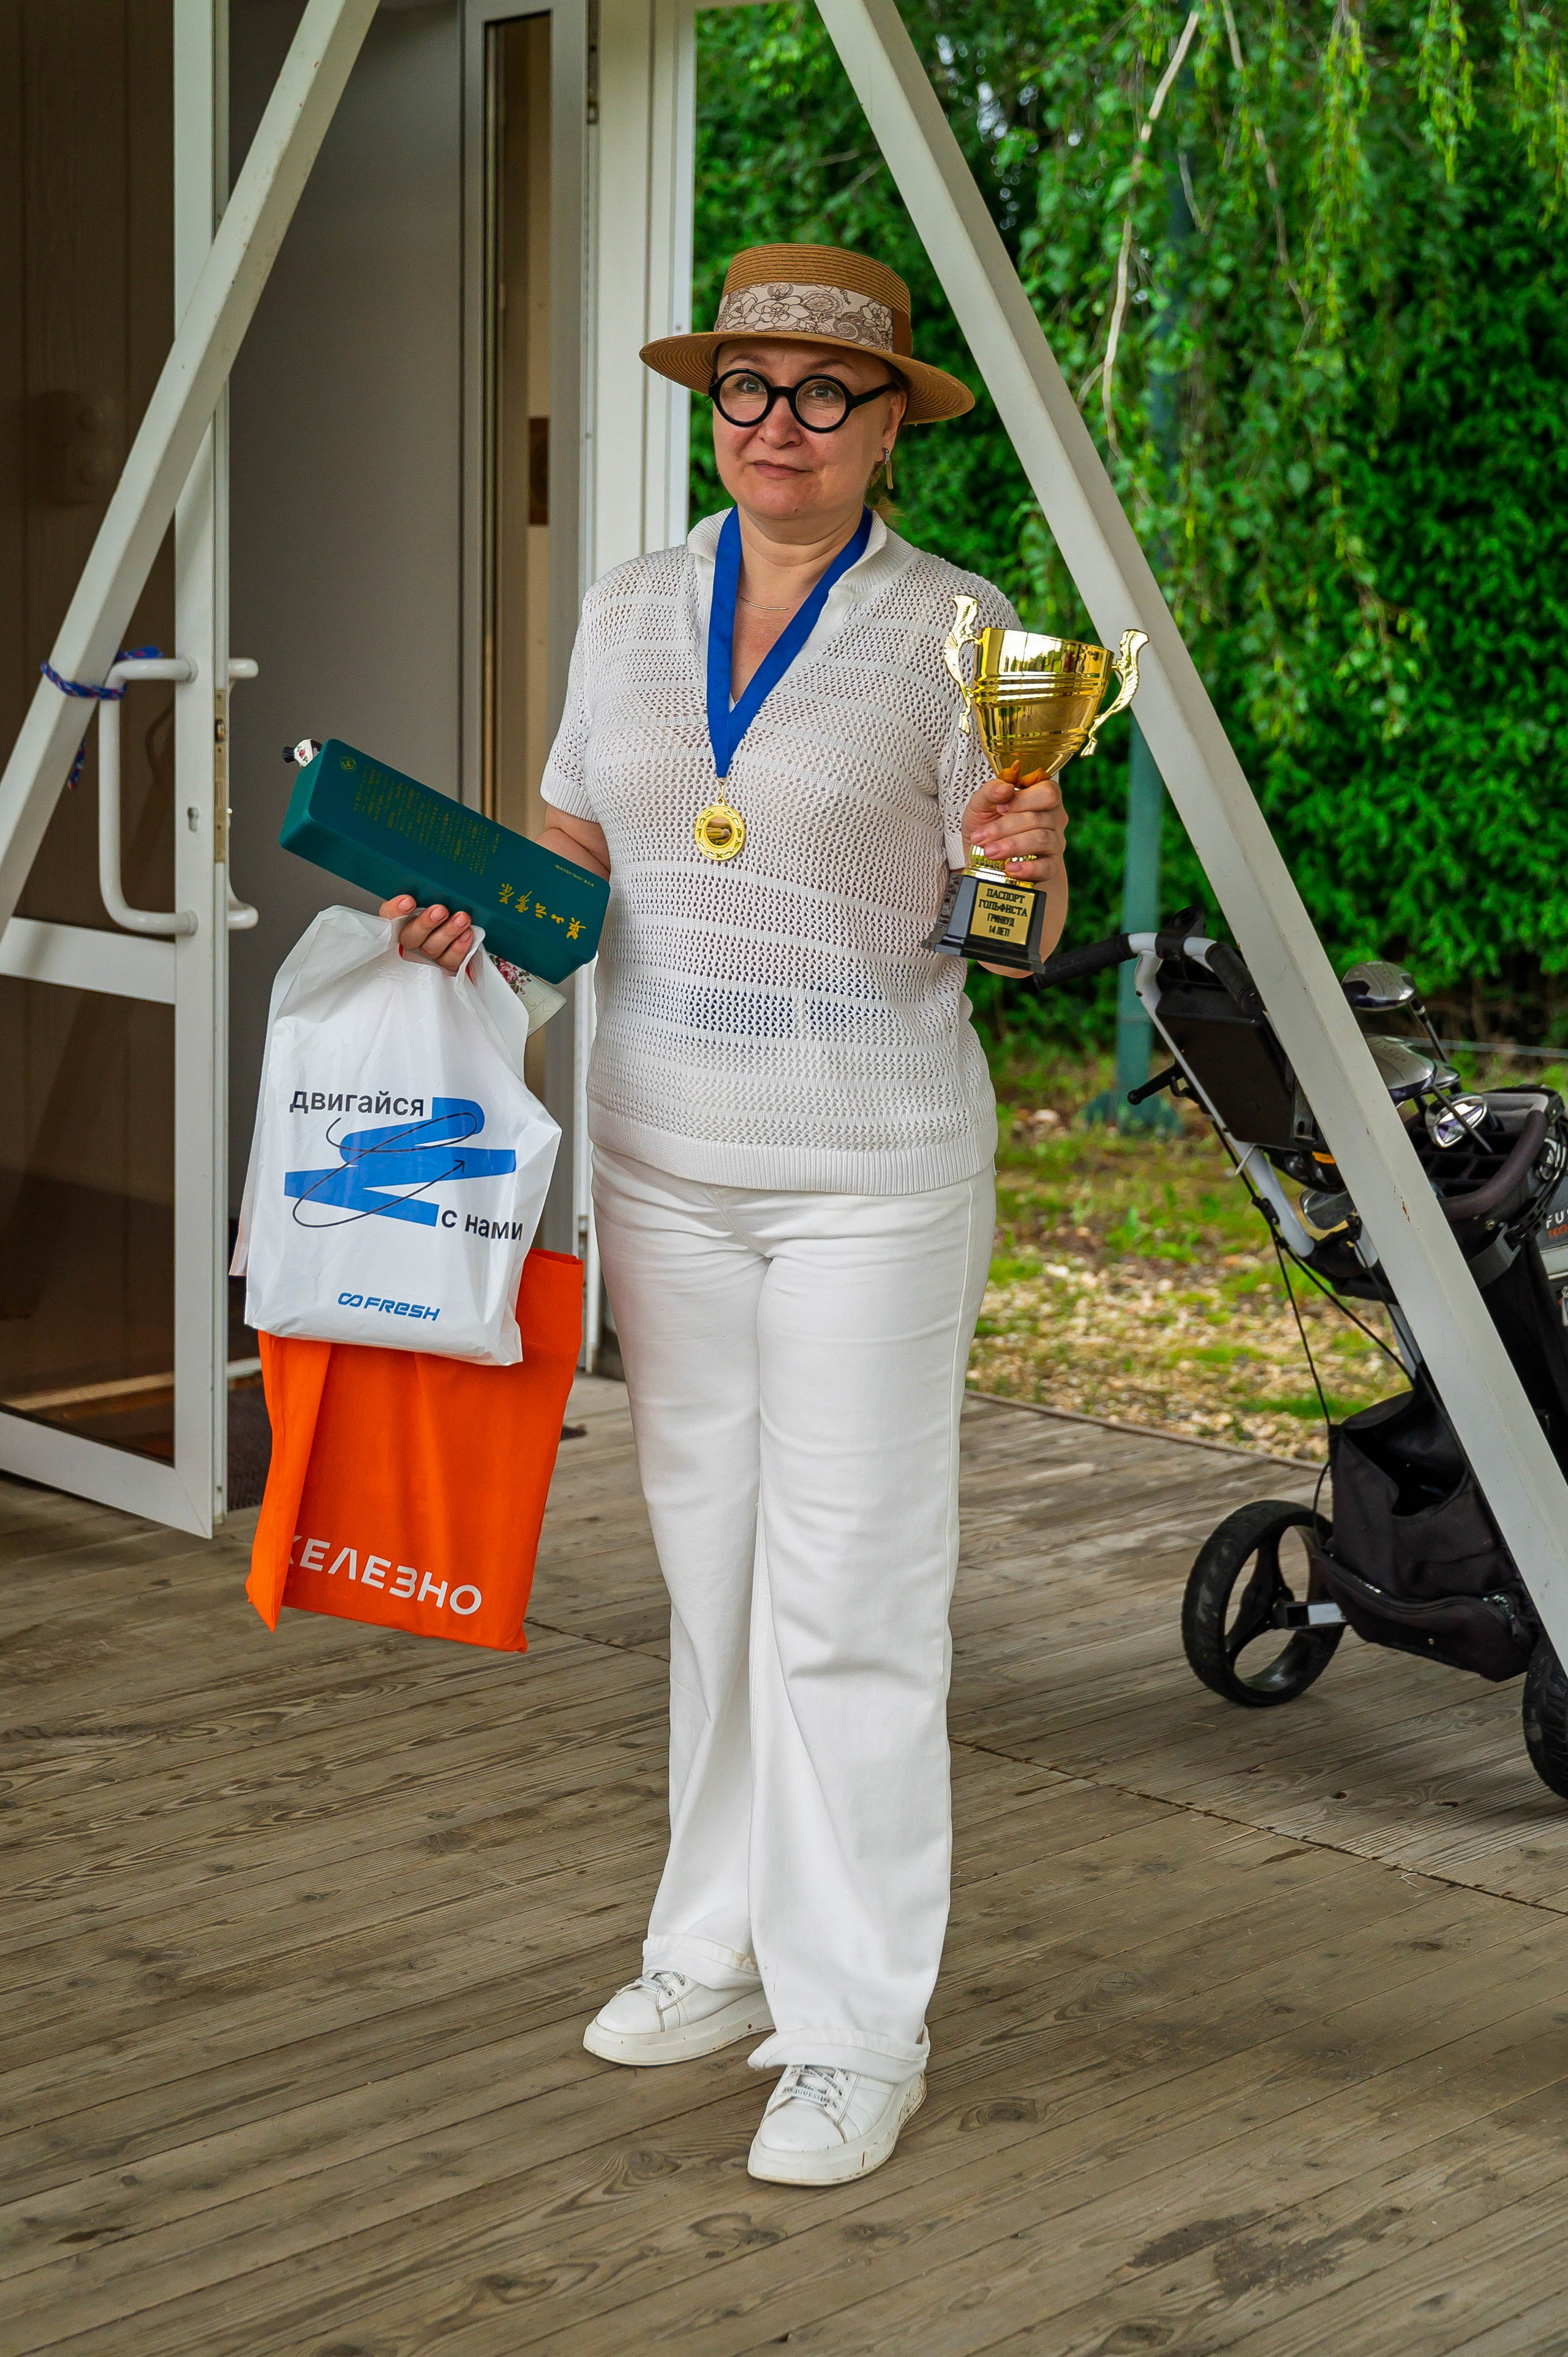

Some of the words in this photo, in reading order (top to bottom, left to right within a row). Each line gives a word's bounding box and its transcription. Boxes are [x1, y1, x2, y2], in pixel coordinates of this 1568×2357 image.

[986, 888, 1025, 903] ПАСПОРТ
[978, 899, 1027, 917] ГОЛЬФИСТА
[987, 913, 1014, 927] ГРИНВУД
[989, 925, 995, 933] 14
[289, 1090, 424, 1117] двигайся
[464, 1213, 523, 1241] нами
[797, 2089, 821, 2100] GUESS
